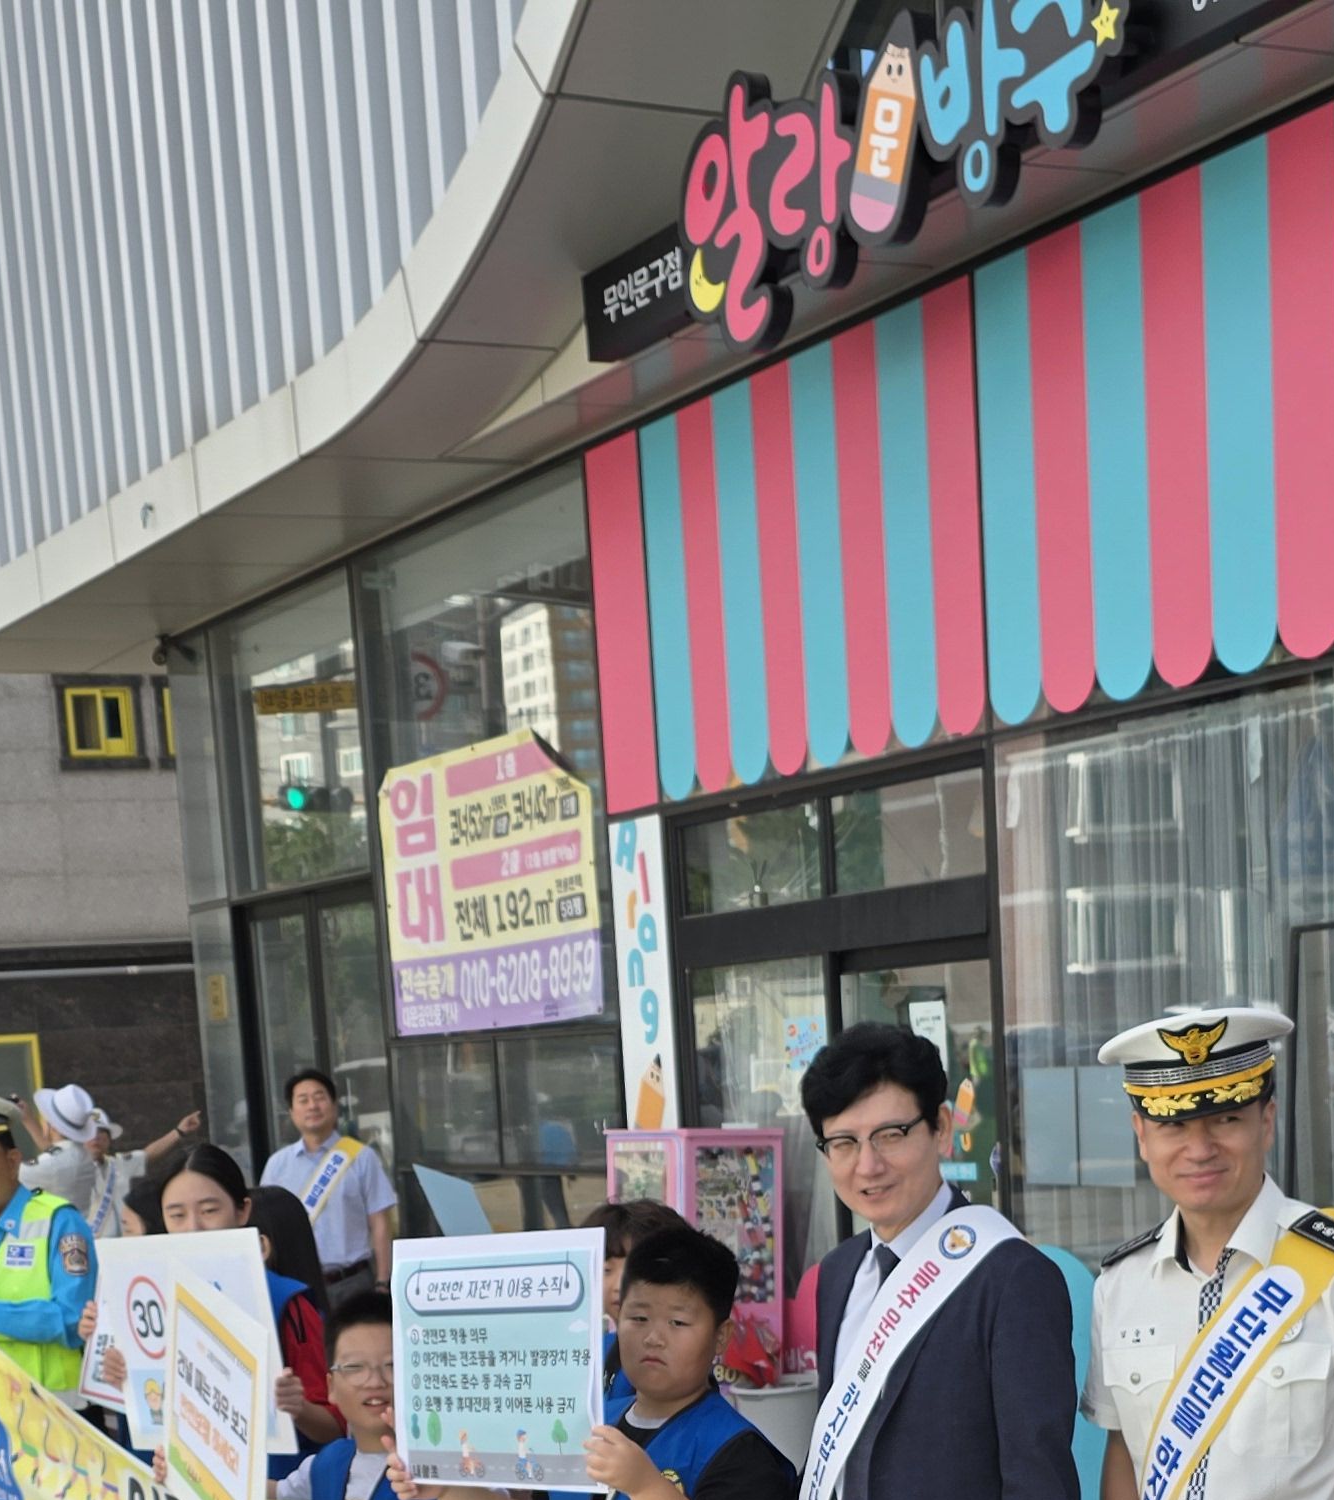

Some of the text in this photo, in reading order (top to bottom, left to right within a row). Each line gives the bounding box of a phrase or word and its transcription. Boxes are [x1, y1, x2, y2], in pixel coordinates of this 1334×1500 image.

[603, 247, 684, 322] 무인문구점
[390, 772, 445, 945] 임대
[460, 938, 596, 1010] 010-6208-8959
[426, 1280, 464, 1302] 안전한
[466, 1278, 505, 1300] 자전거
[507, 1276, 534, 1299] 이용
[131, 1299, 165, 1339] 30
[421, 1328, 447, 1345] 안전모
[449, 1327, 468, 1345] 착용
[469, 1327, 489, 1344] 의무
[856, 1258, 941, 1384] 음주운전을
[459, 1350, 496, 1368] 전조등을
[499, 1349, 527, 1367] 켜거나
[530, 1348, 568, 1367] 발광장치
[571, 1348, 591, 1367] 착용
[1170, 1277, 1294, 1440] 무단횡단을
[423, 1373, 458, 1391] 안전속도
[459, 1373, 480, 1391] 준수
[492, 1374, 511, 1391] 과속
[513, 1373, 533, 1391] 금지
[455, 1395, 492, 1414] 휴대전화
[505, 1396, 534, 1414] 이어폰
[536, 1396, 555, 1414] 사용
[556, 1396, 577, 1415] 금지
